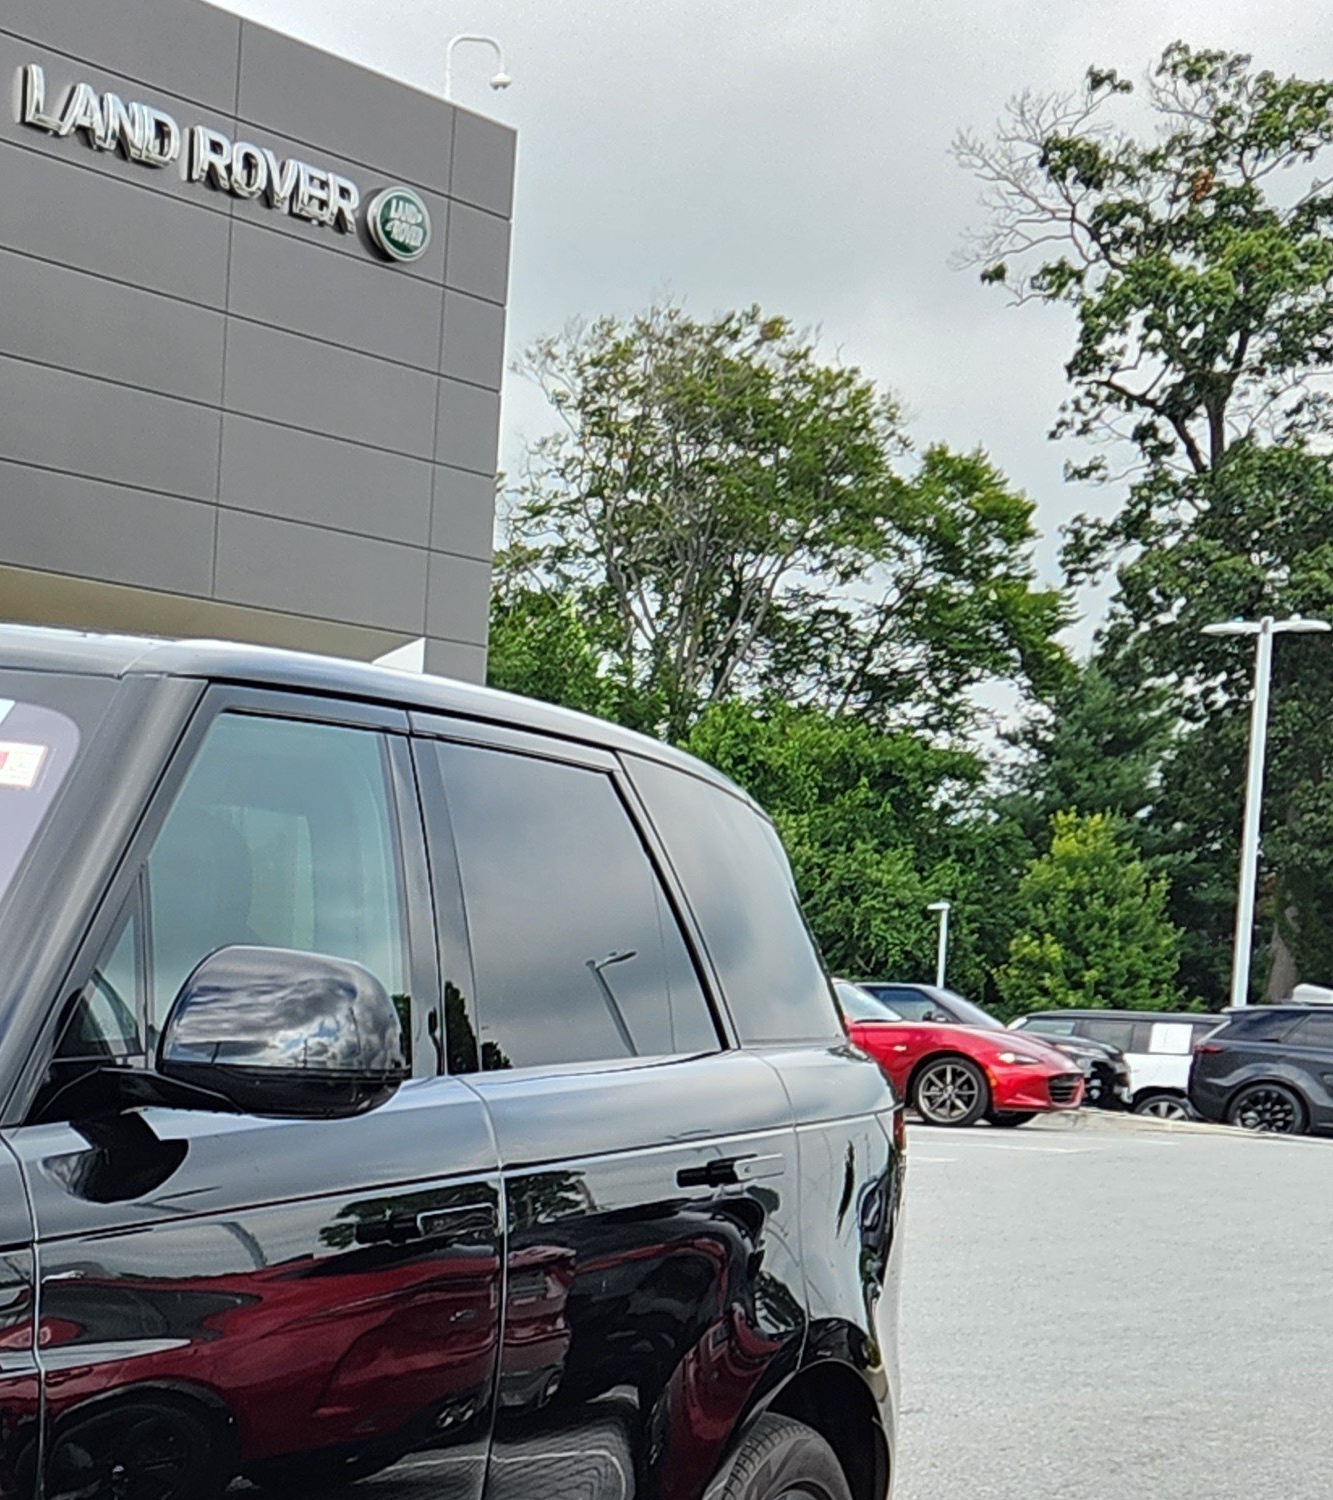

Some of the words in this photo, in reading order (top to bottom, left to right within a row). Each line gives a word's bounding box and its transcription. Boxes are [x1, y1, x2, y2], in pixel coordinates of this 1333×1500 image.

[16, 64, 178, 168] LAND
[182, 124, 359, 235] ROVER
[390, 199, 422, 224] LAND
